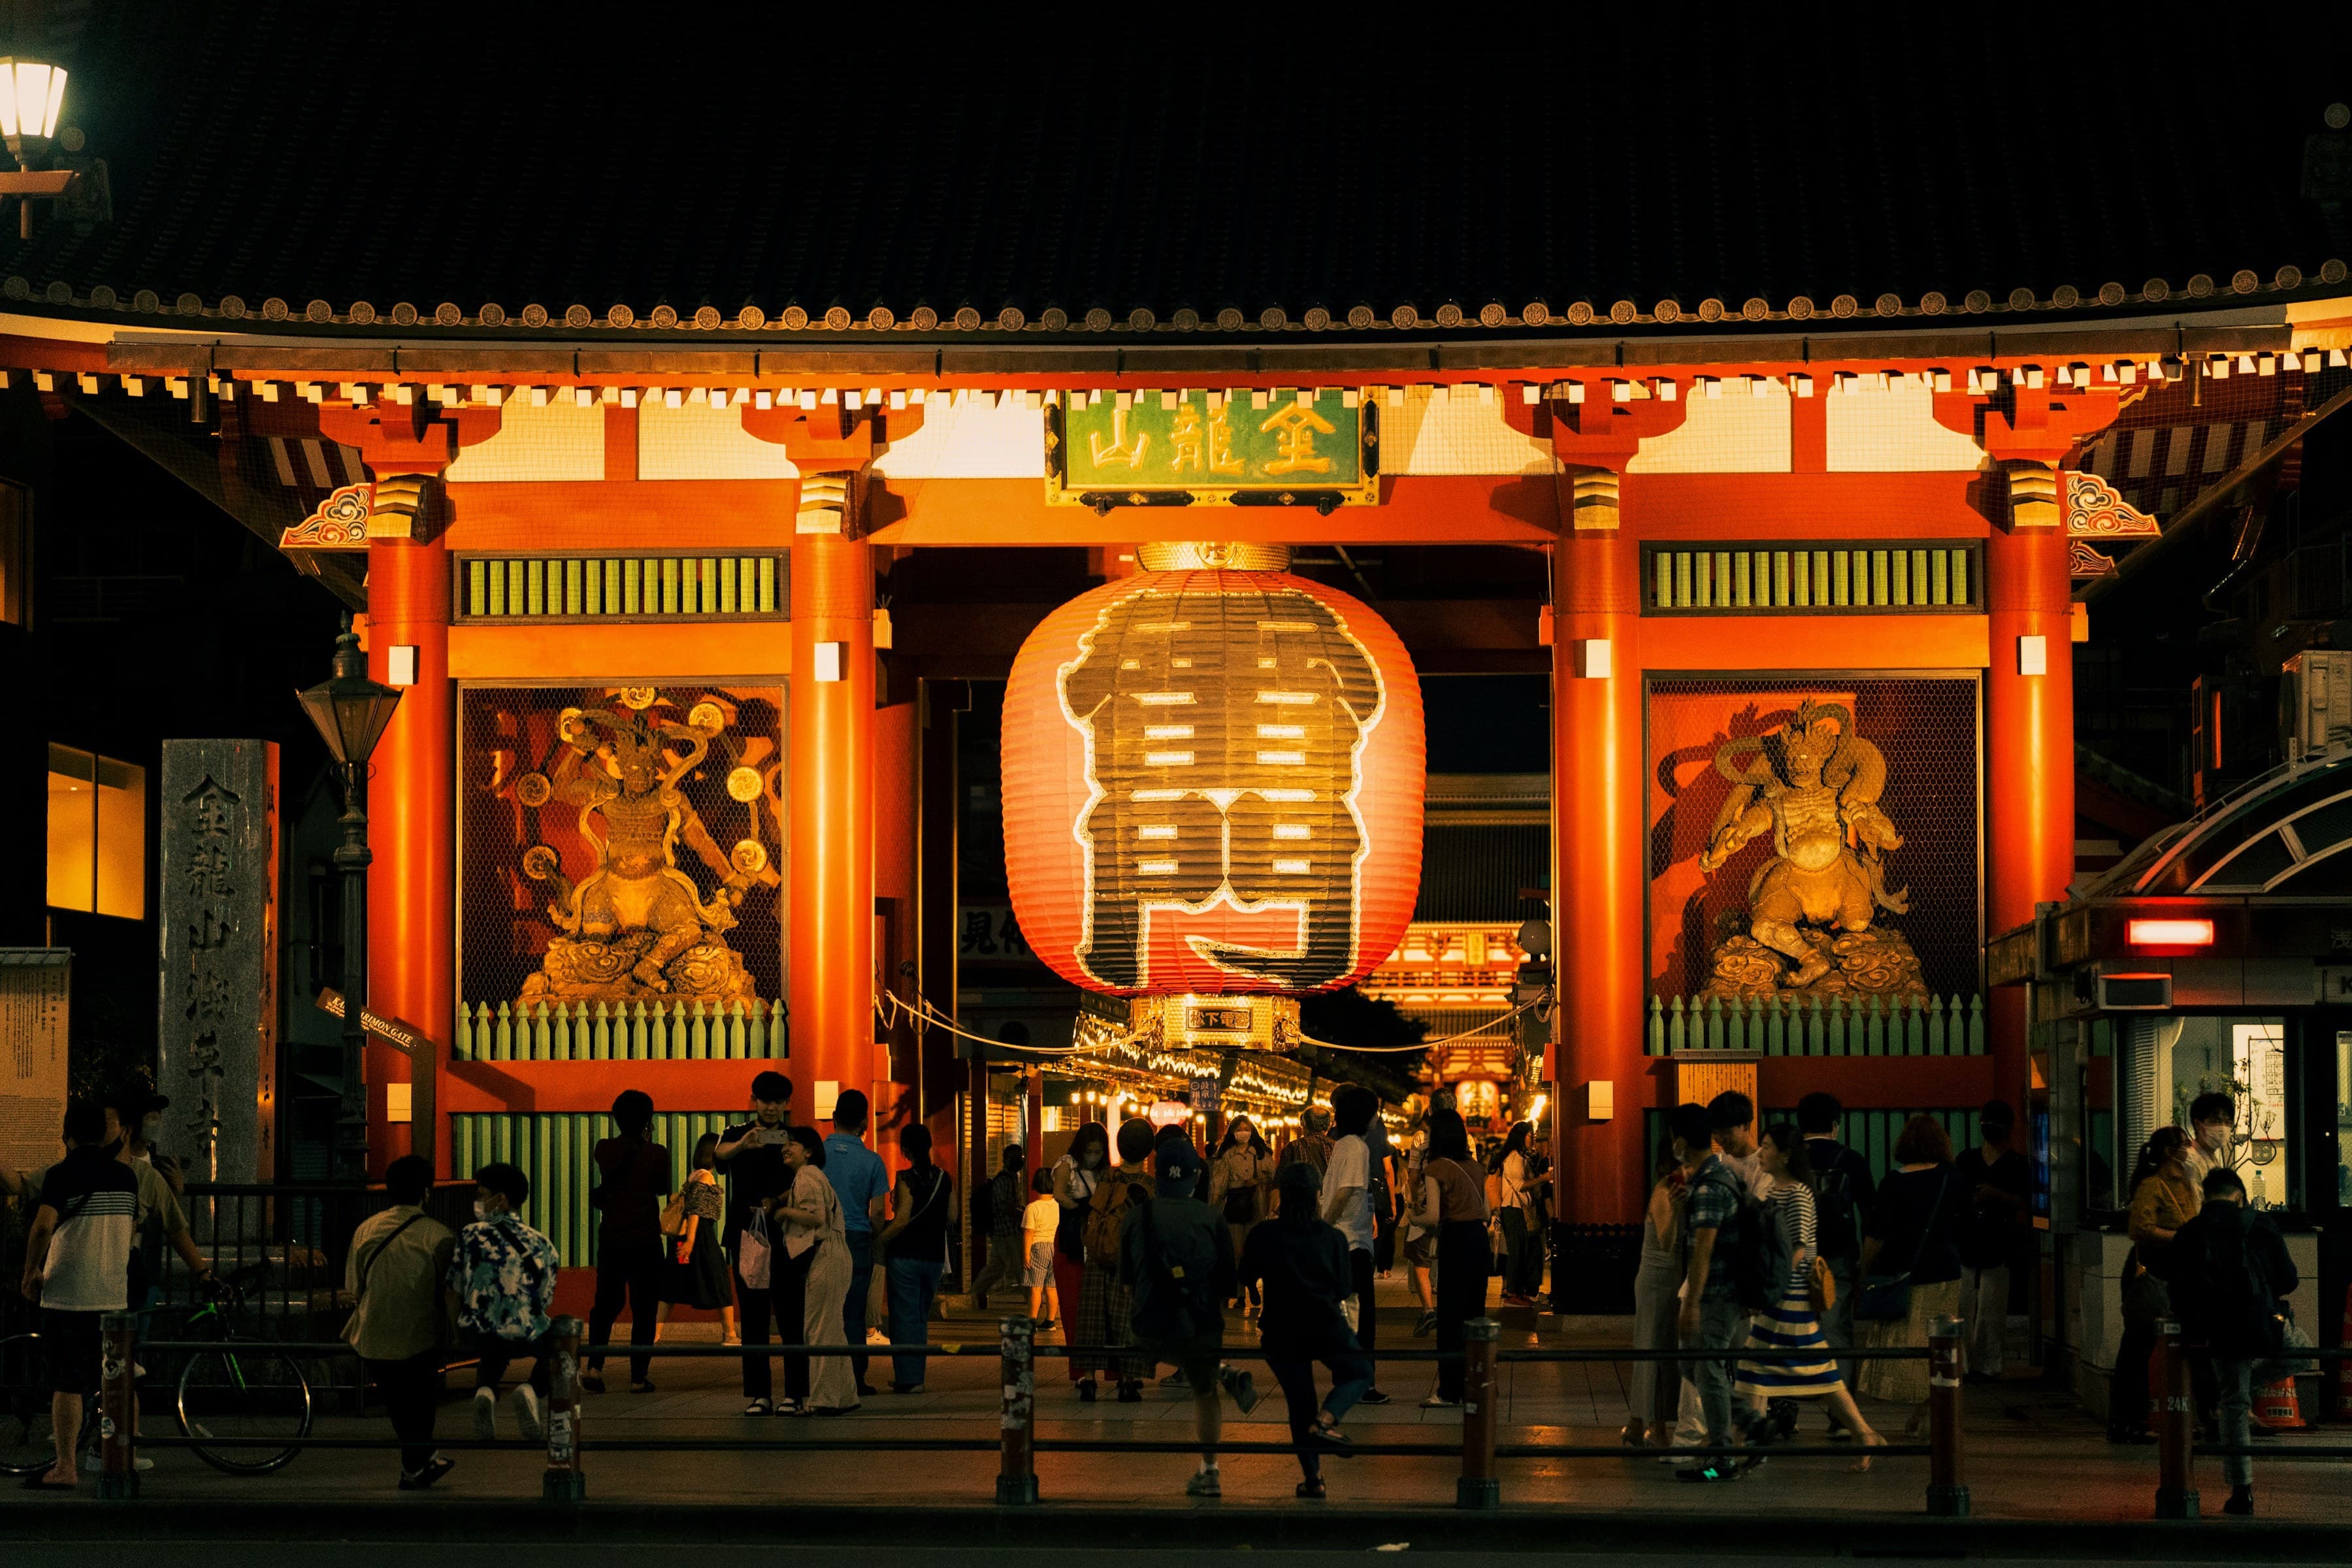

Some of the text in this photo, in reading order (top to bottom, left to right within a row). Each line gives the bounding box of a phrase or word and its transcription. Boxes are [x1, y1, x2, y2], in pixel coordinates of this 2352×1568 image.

[1057, 589, 1386, 989] 雷門
[332, 996, 391, 1032] KAARIMON
[390, 1028, 414, 1044] GATE
